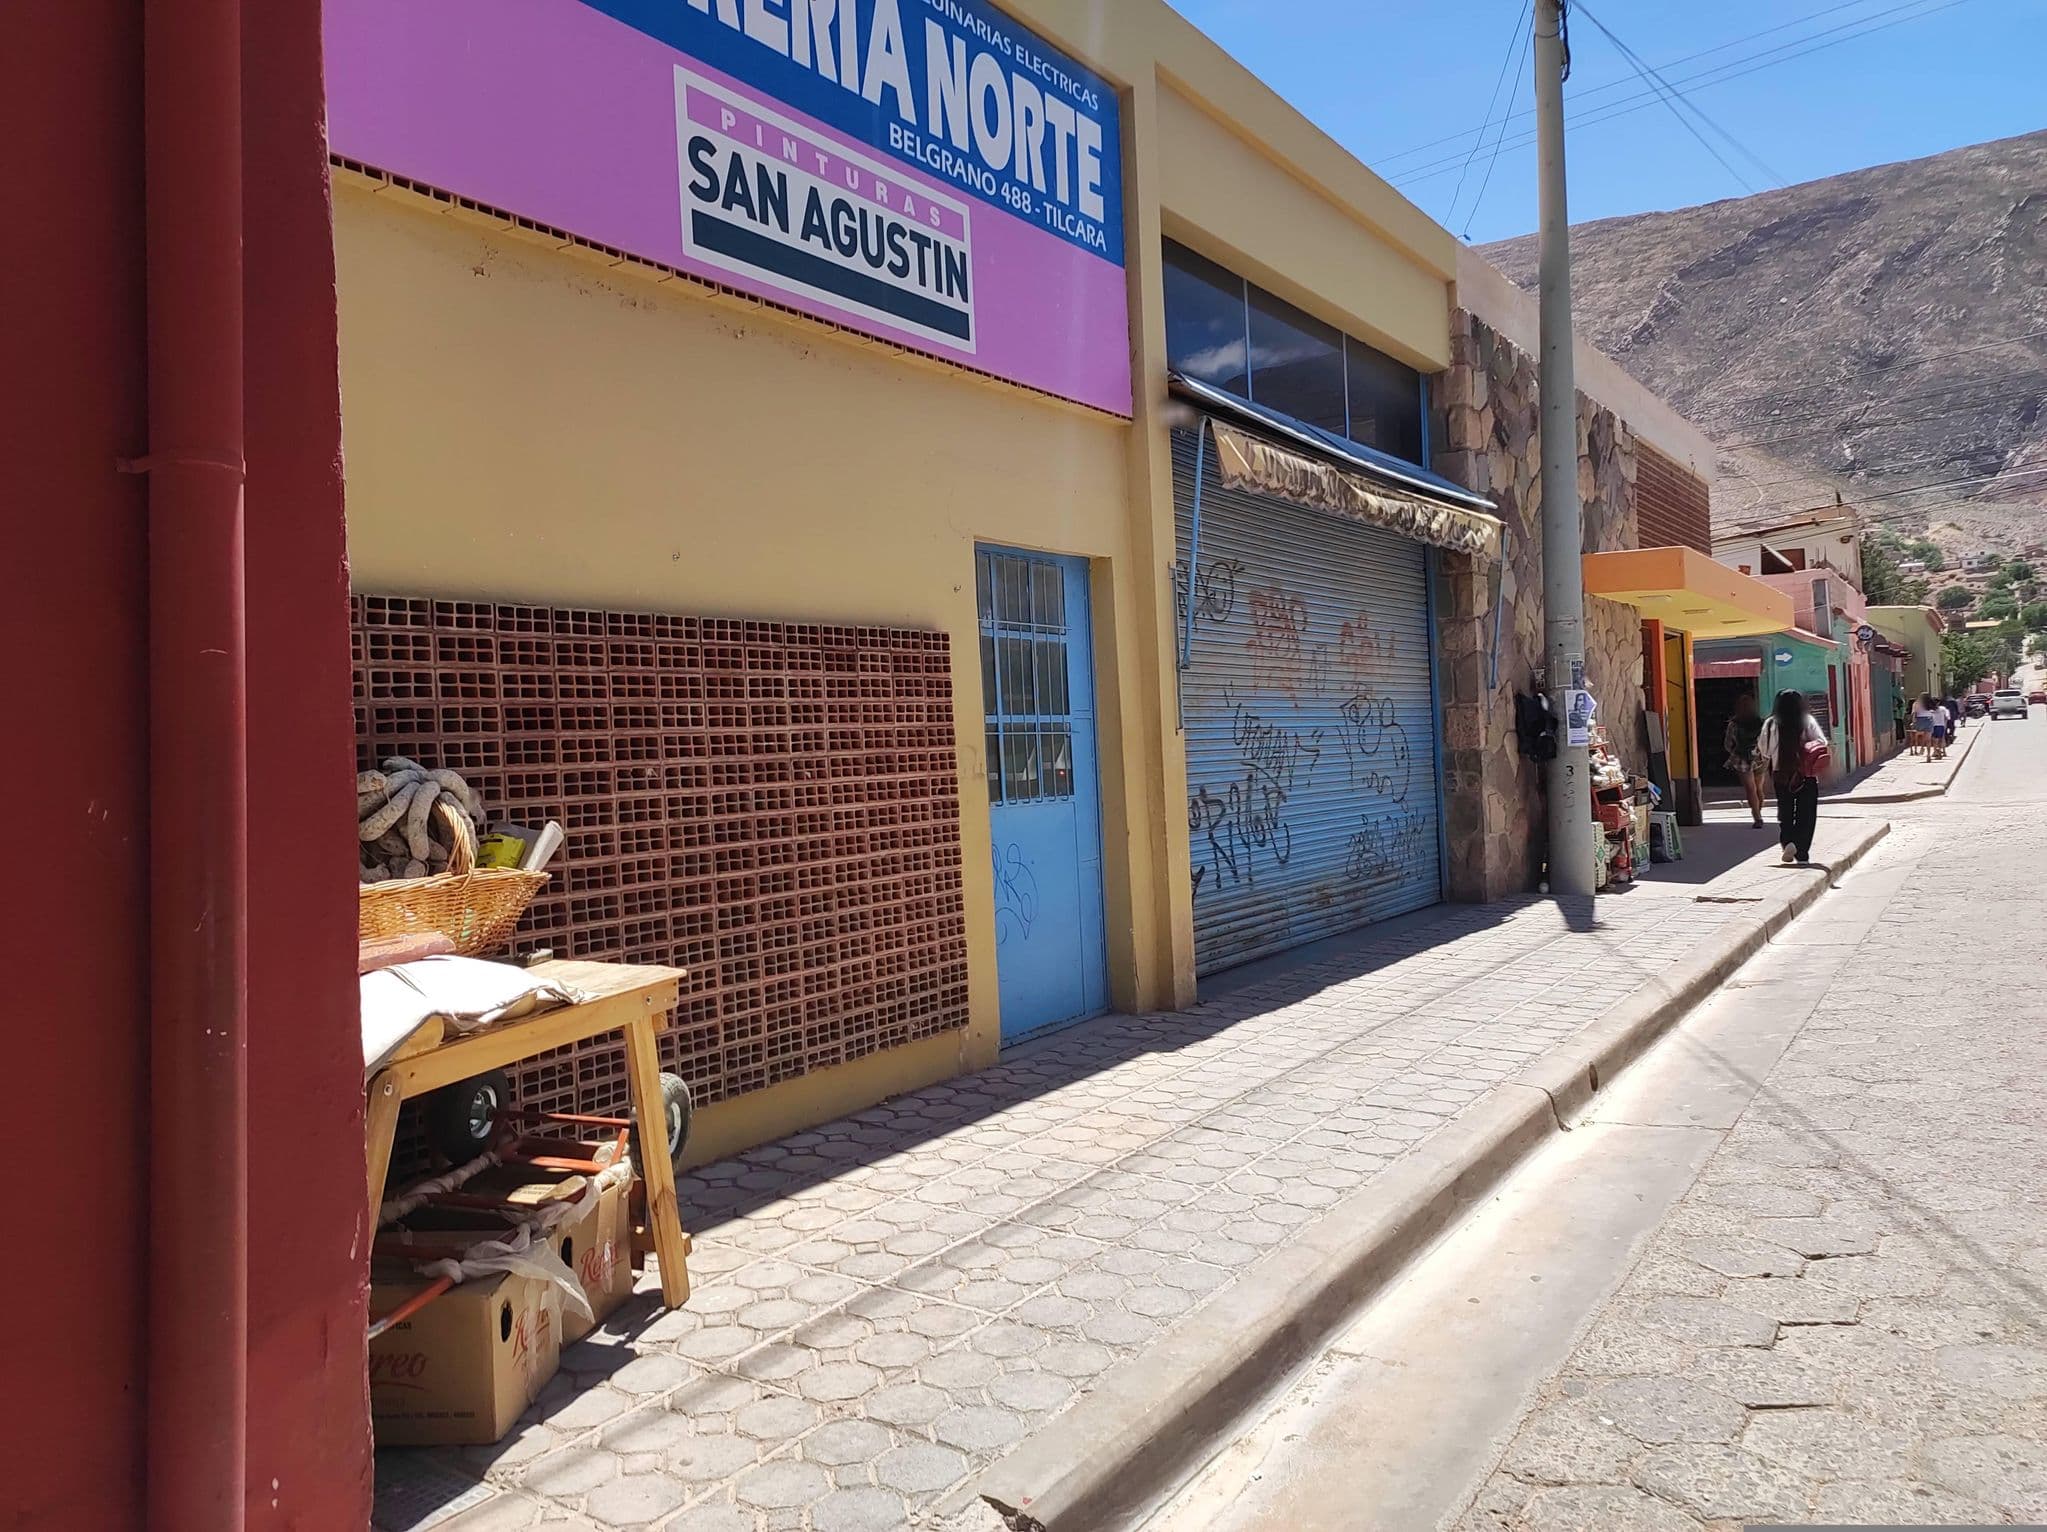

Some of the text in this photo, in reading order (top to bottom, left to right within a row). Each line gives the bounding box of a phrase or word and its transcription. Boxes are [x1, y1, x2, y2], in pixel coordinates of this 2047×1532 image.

[921, 0, 1099, 110] UINARIAS ELECTRICAS
[720, 107, 941, 228] PINTURAS
[925, 17, 1105, 223] NORTE
[687, 135, 969, 303] SAN AGUSTIN
[889, 122, 996, 196] BELGRANO
[1000, 181, 1031, 214] 488
[1043, 201, 1107, 252] TILCARA
[1565, 765, 1575, 777] 3
